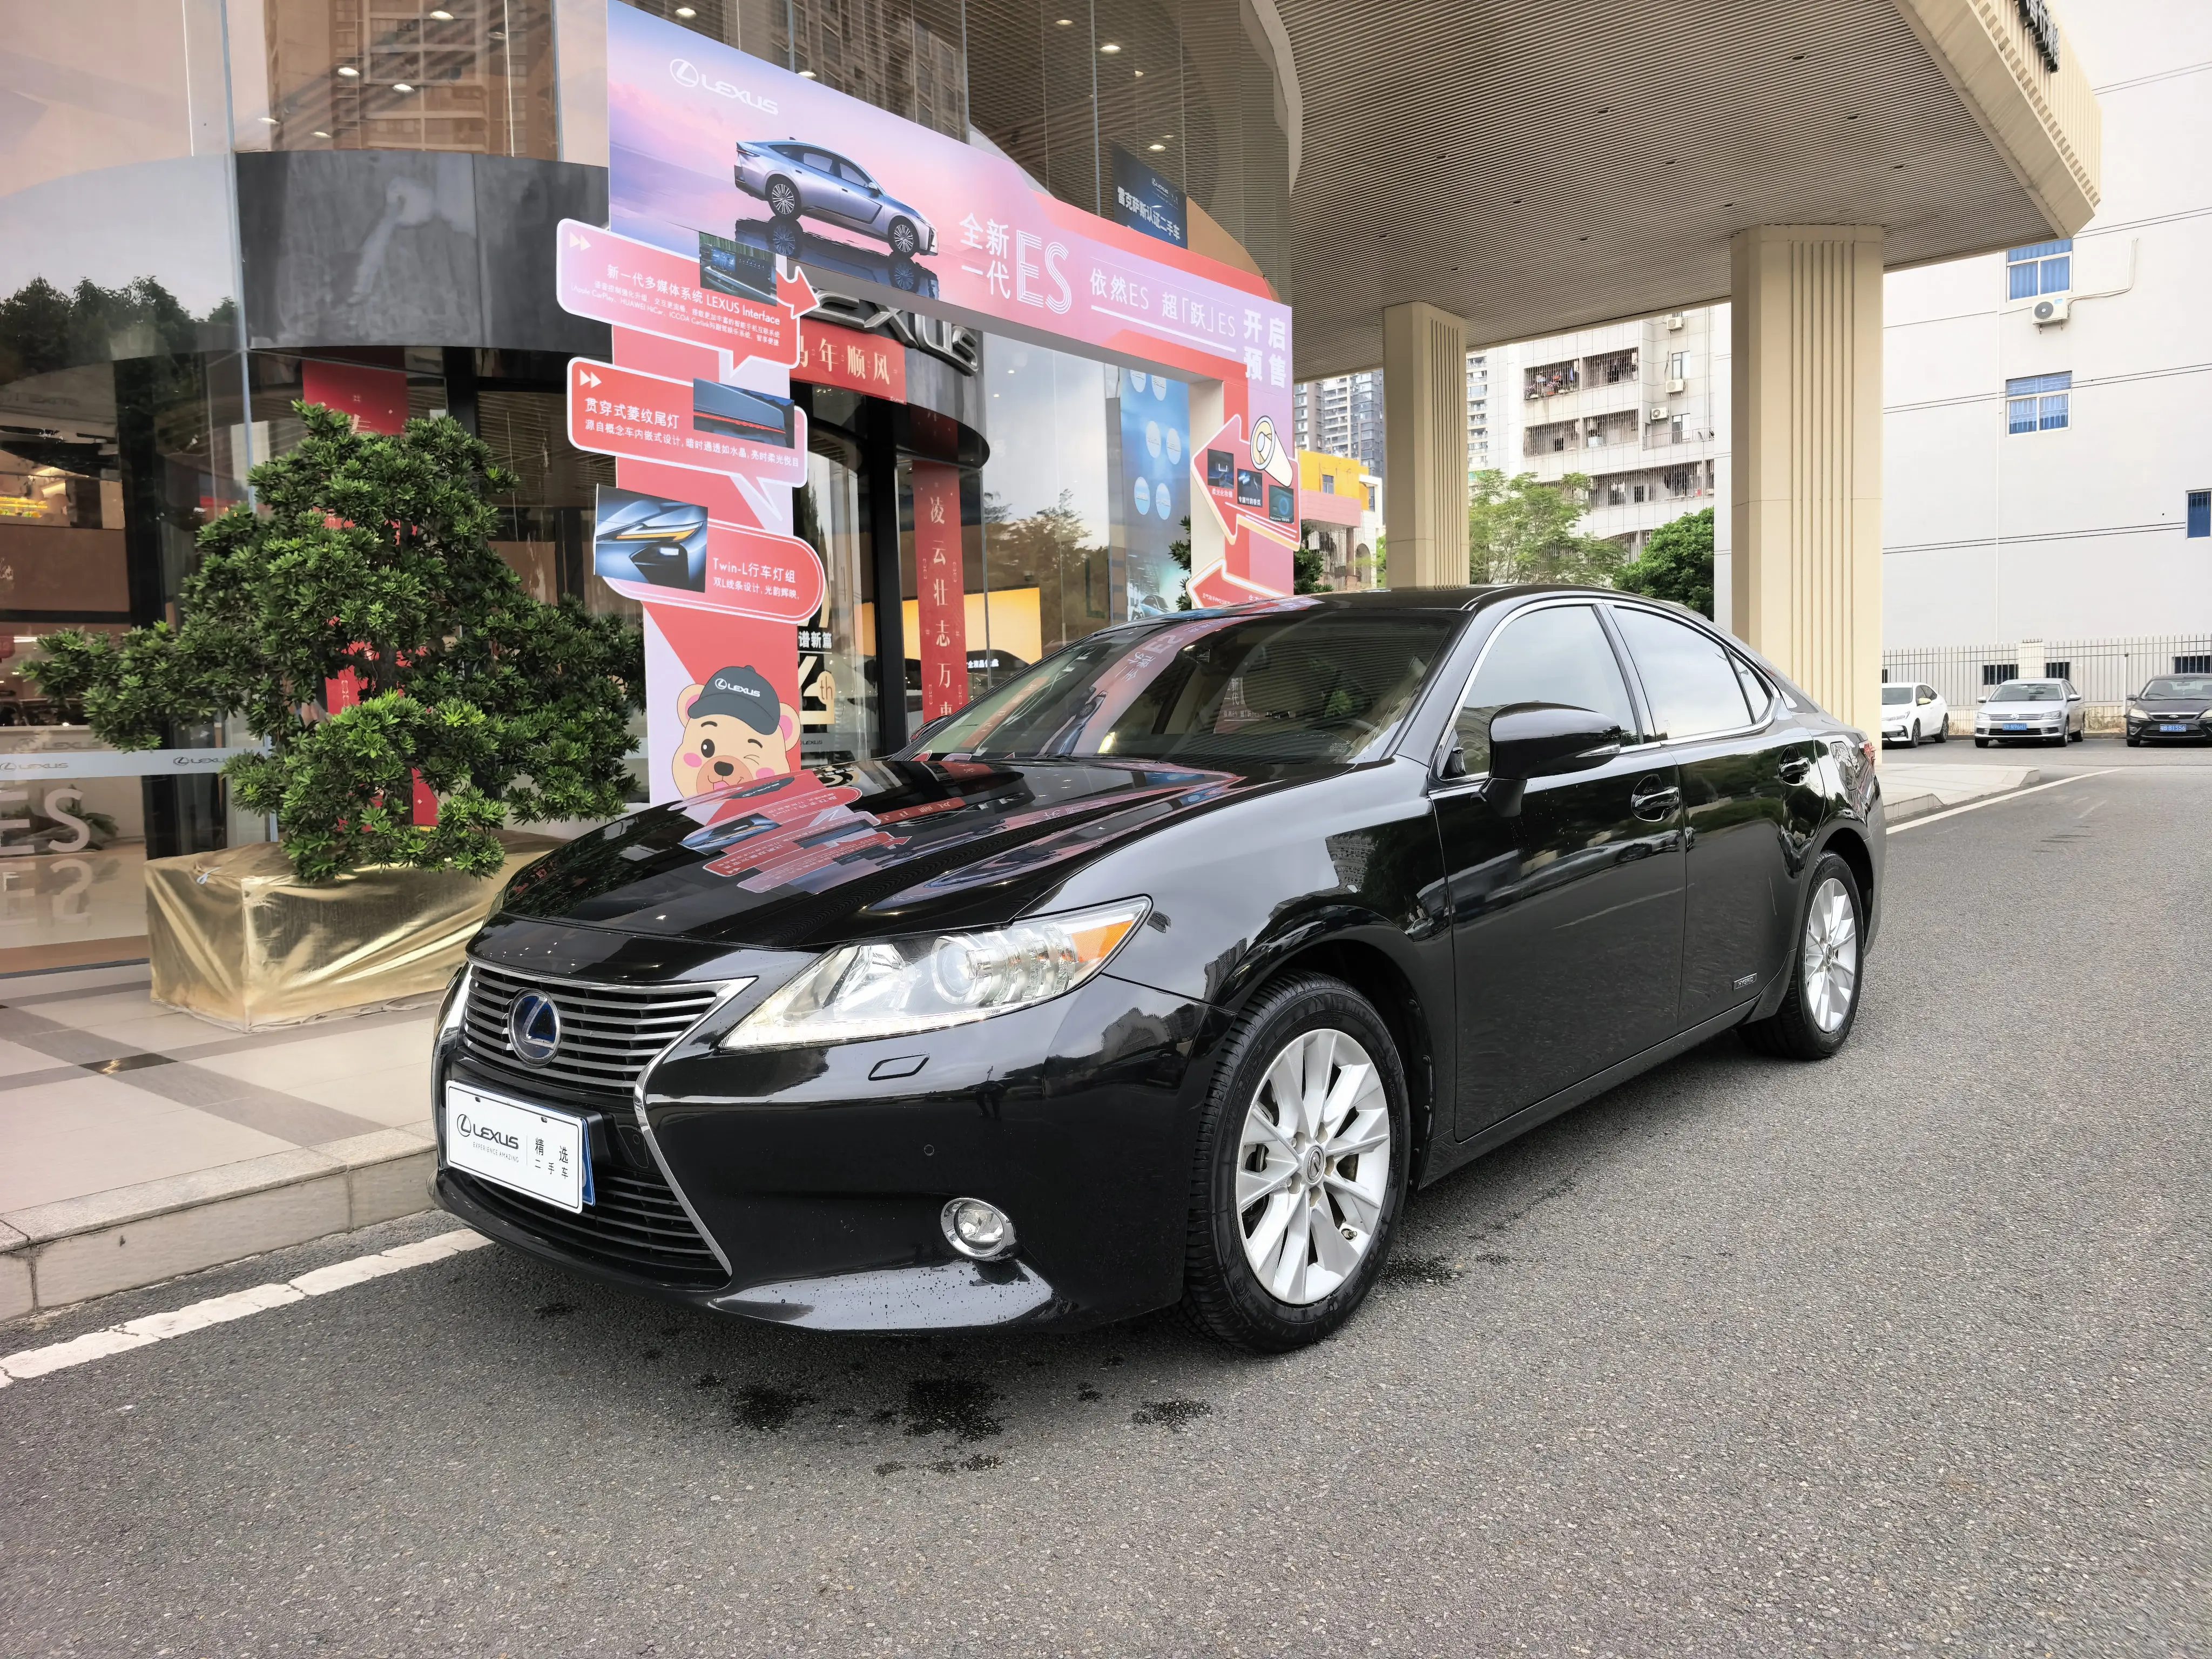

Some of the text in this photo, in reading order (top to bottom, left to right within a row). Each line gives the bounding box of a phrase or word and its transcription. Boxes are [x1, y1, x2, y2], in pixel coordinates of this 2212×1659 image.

[702, 74, 779, 115] LEXUS
[959, 213, 1010, 259] 全新
[961, 260, 1011, 300] 一代
[1016, 230, 1071, 314] ES
[1090, 268, 1149, 310] 依然ES
[607, 264, 780, 325] 新一代多媒体系统 LEXUS Interface
[812, 286, 979, 374] EXUS
[1243, 308, 1285, 351] 开启
[1243, 346, 1286, 389] 预售
[584, 397, 679, 429] 贯穿式菱纹尾灯
[713, 557, 796, 583] Twin-L行车灯组
[798, 631, 832, 649] 谱新篇
[727, 683, 760, 697] LEXUS
[819, 675, 833, 700] th
[473, 1123, 518, 1150] LEXUS
[473, 1141, 519, 1163] EXPERIENCE AMAZING
[535, 1137, 568, 1164] 精选
[535, 1159, 568, 1179] 二手车
